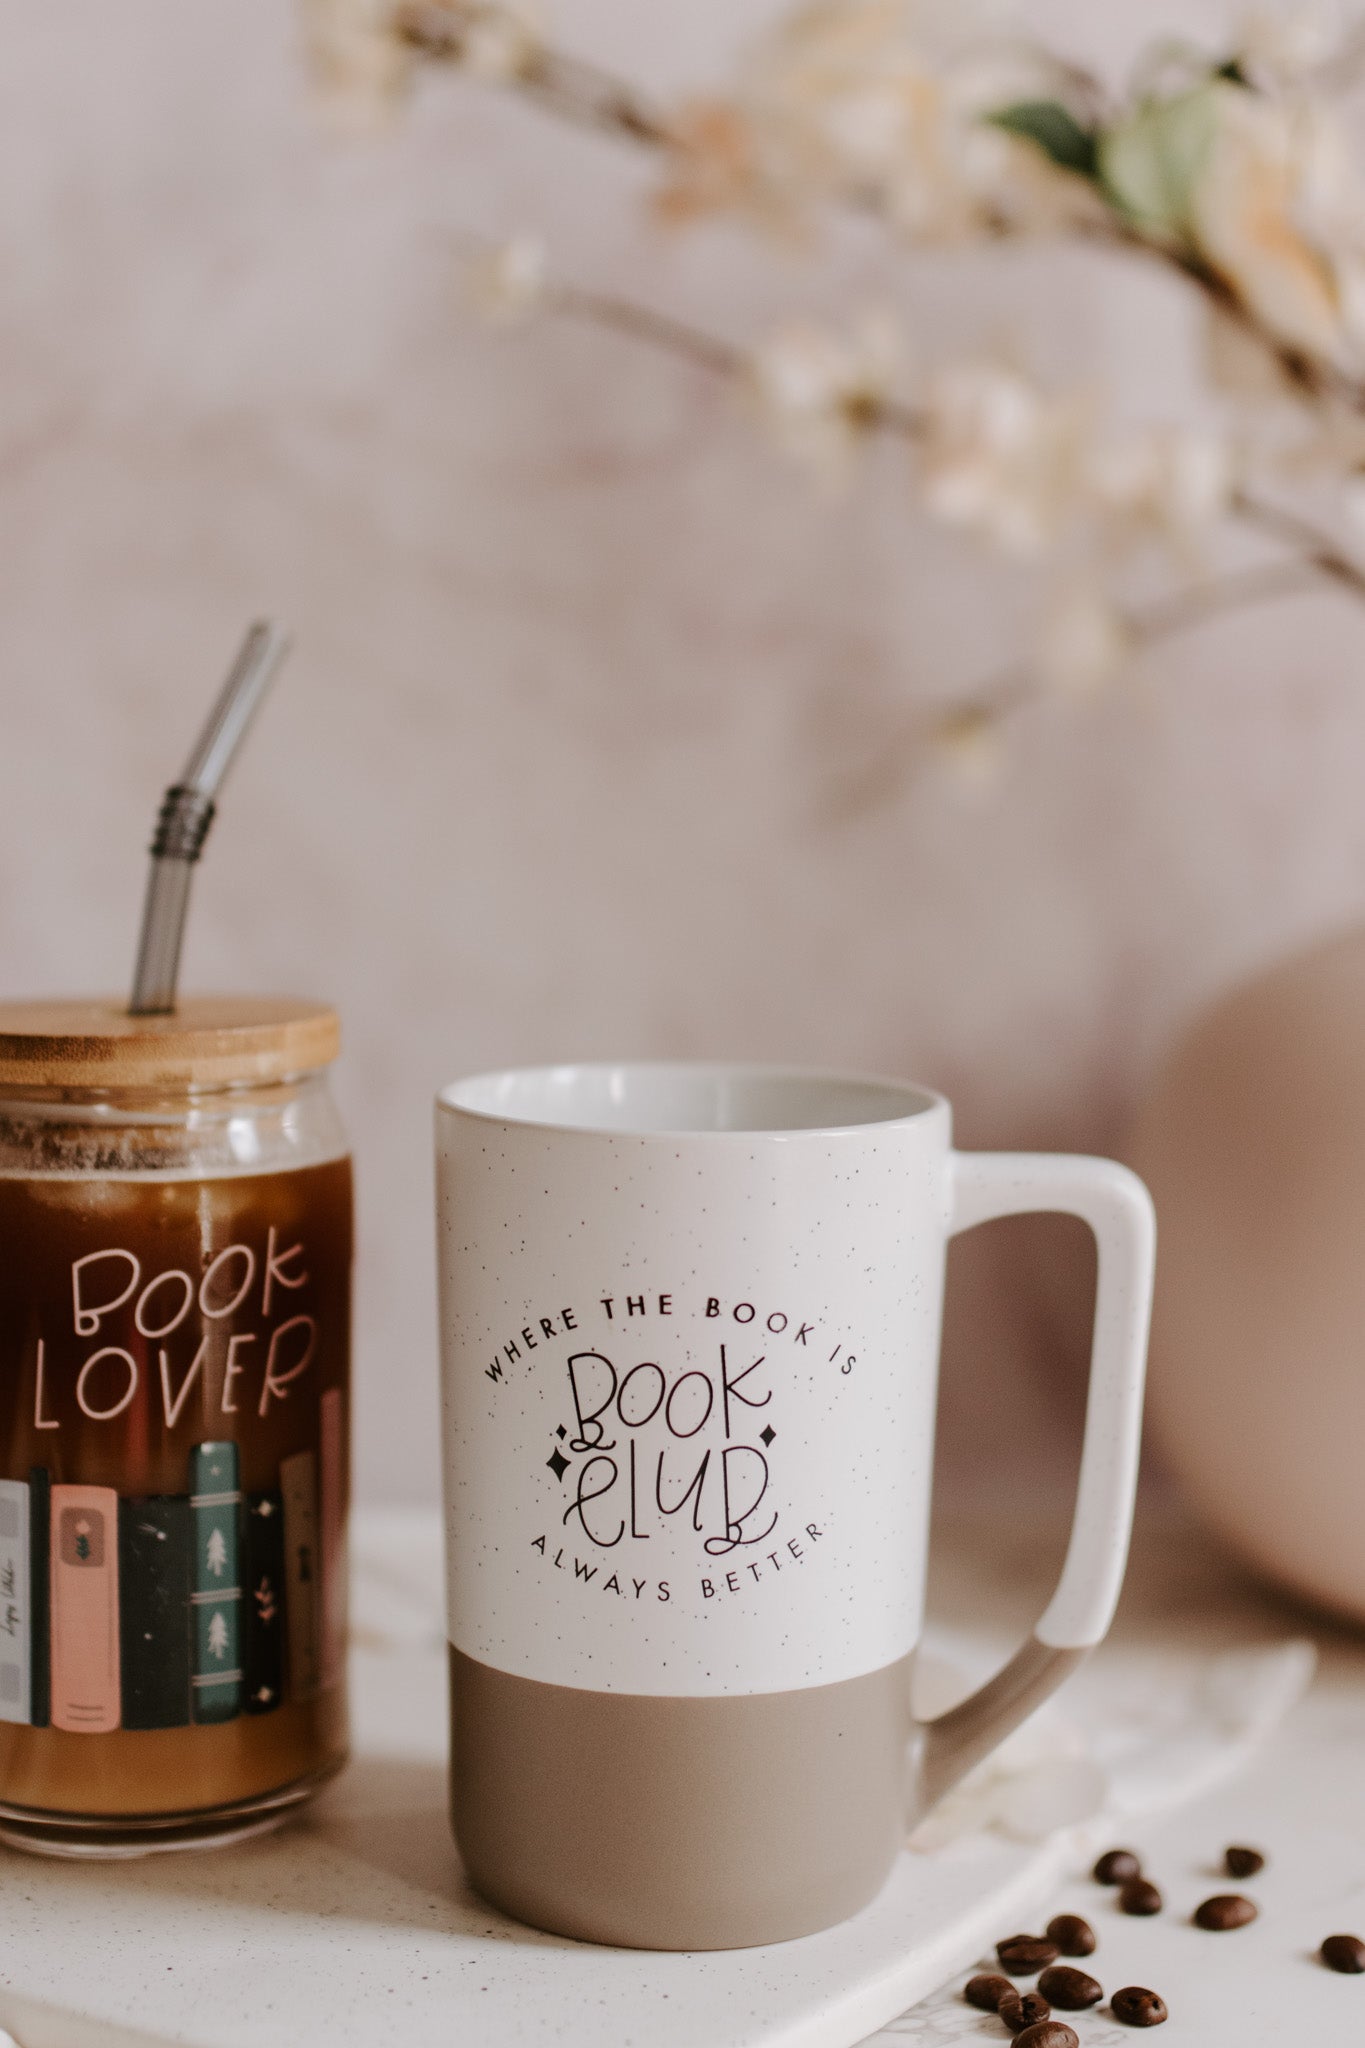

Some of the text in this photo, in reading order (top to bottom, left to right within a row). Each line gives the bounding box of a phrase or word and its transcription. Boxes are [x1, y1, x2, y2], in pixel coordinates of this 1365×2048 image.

[72, 1226, 308, 1338] BOOK
[34, 1314, 315, 1429] LOVER
[484, 1294, 857, 1384] WHERE THE BOOK IS
[567, 1344, 772, 1452] BOOK
[563, 1439, 779, 1555] CLUB
[531, 1522, 823, 1602] ALWAYS BETTER
